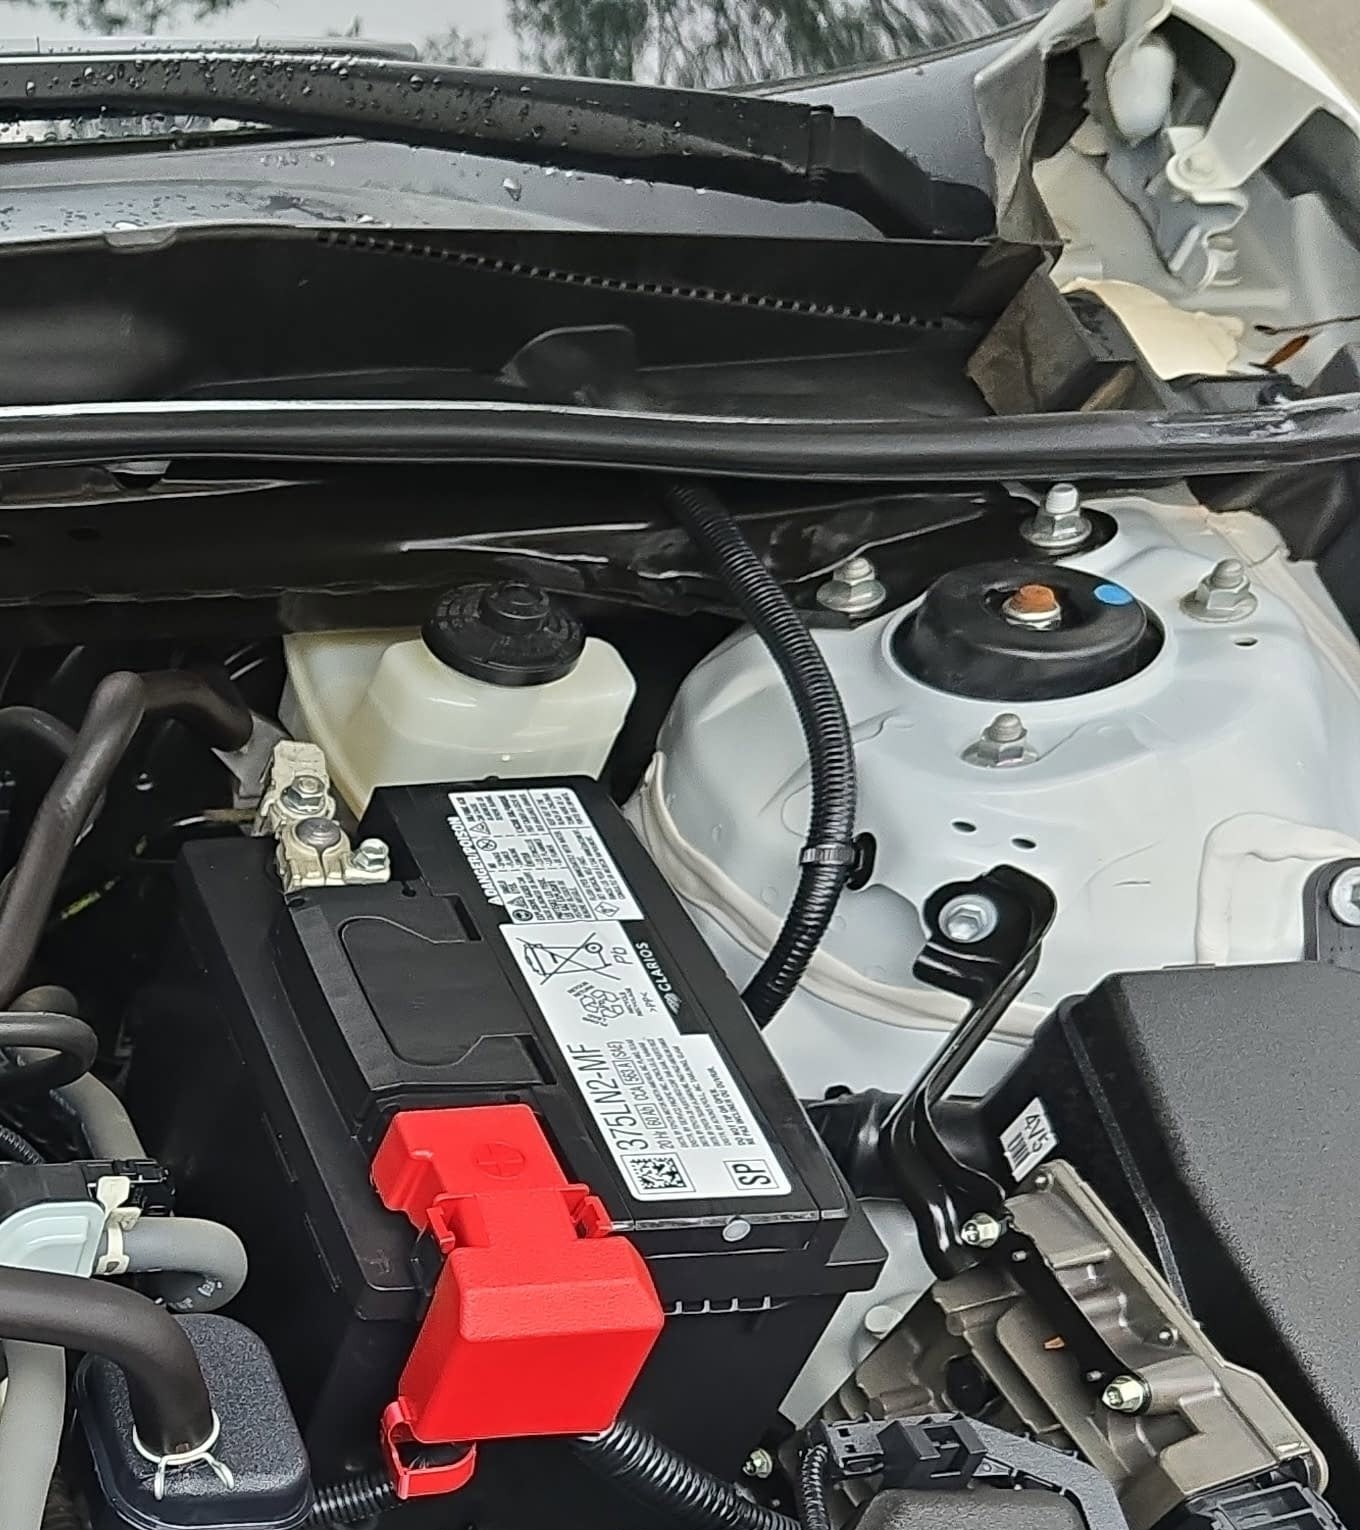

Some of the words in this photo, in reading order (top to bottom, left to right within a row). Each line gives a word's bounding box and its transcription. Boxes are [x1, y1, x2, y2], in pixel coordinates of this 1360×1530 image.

[611, 947, 632, 964] Pb
[636, 942, 672, 992] CLARIOS
[606, 1040, 627, 1060] (SAE)
[620, 1069, 639, 1082] 563
[567, 1045, 648, 1149] 375LN2-MF
[630, 1086, 649, 1101] CCA
[645, 1117, 662, 1126] 60
[657, 1140, 674, 1149] 20
[732, 1164, 771, 1185] SP
